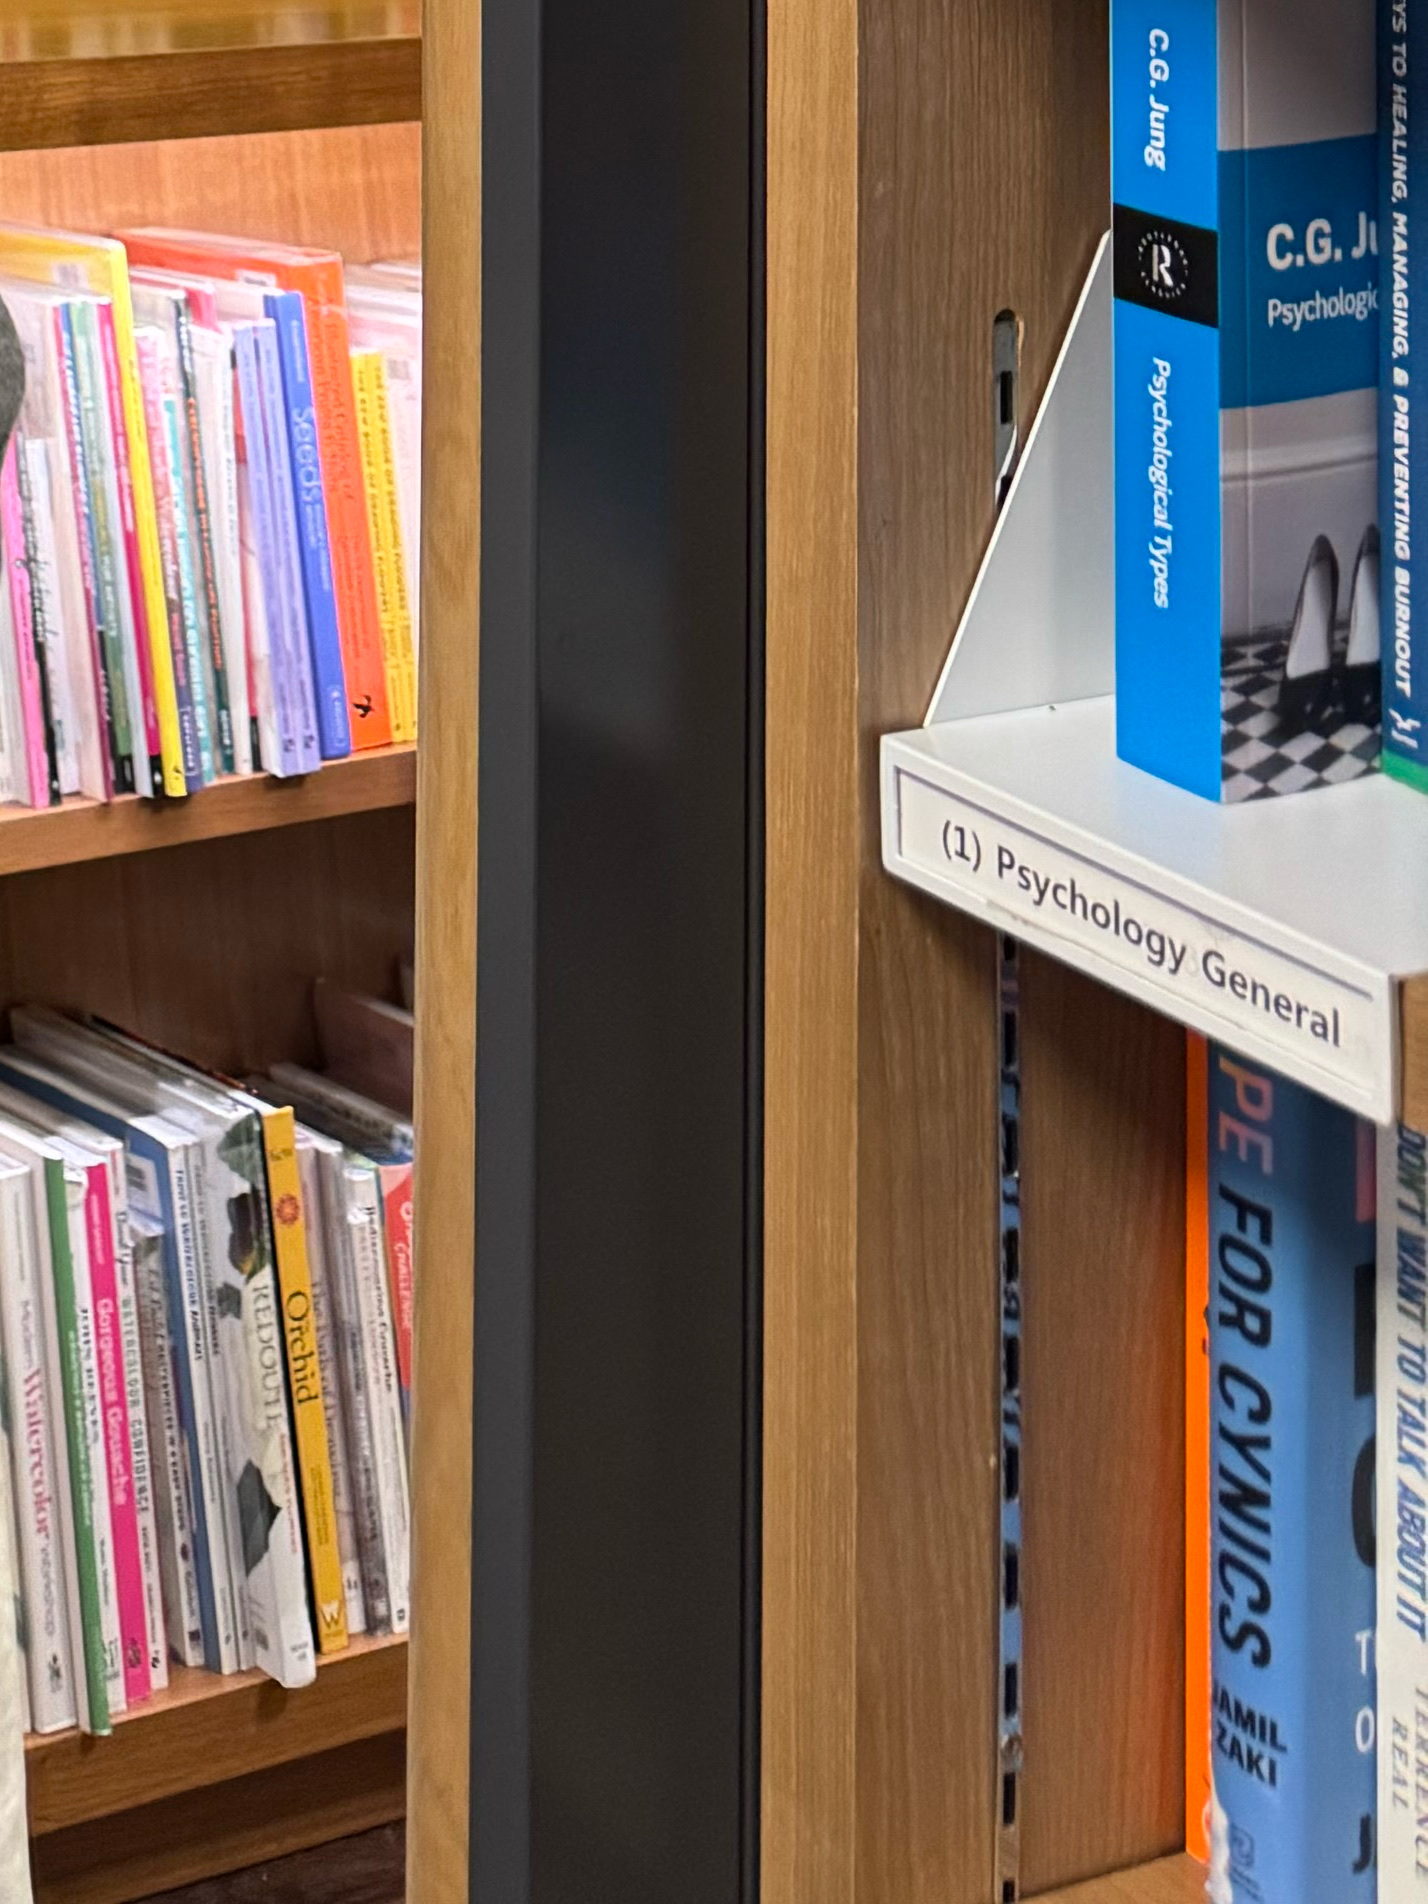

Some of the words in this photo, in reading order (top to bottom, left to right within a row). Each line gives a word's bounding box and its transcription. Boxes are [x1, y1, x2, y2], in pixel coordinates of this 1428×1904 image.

[1148, 28, 1170, 89] C.G.
[1144, 94, 1170, 171] Jung
[1267, 220, 1342, 272] C.G.
[1141, 357, 1173, 527] Psychological
[1152, 532, 1173, 610] Types
[940, 820, 985, 873] (1)
[996, 840, 1188, 976] Psychology
[1202, 936, 1343, 1049] General
[1218, 1182, 1275, 1350] FOR
[285, 1290, 320, 1405] Orchid
[1216, 1361, 1275, 1671] CYNICS
